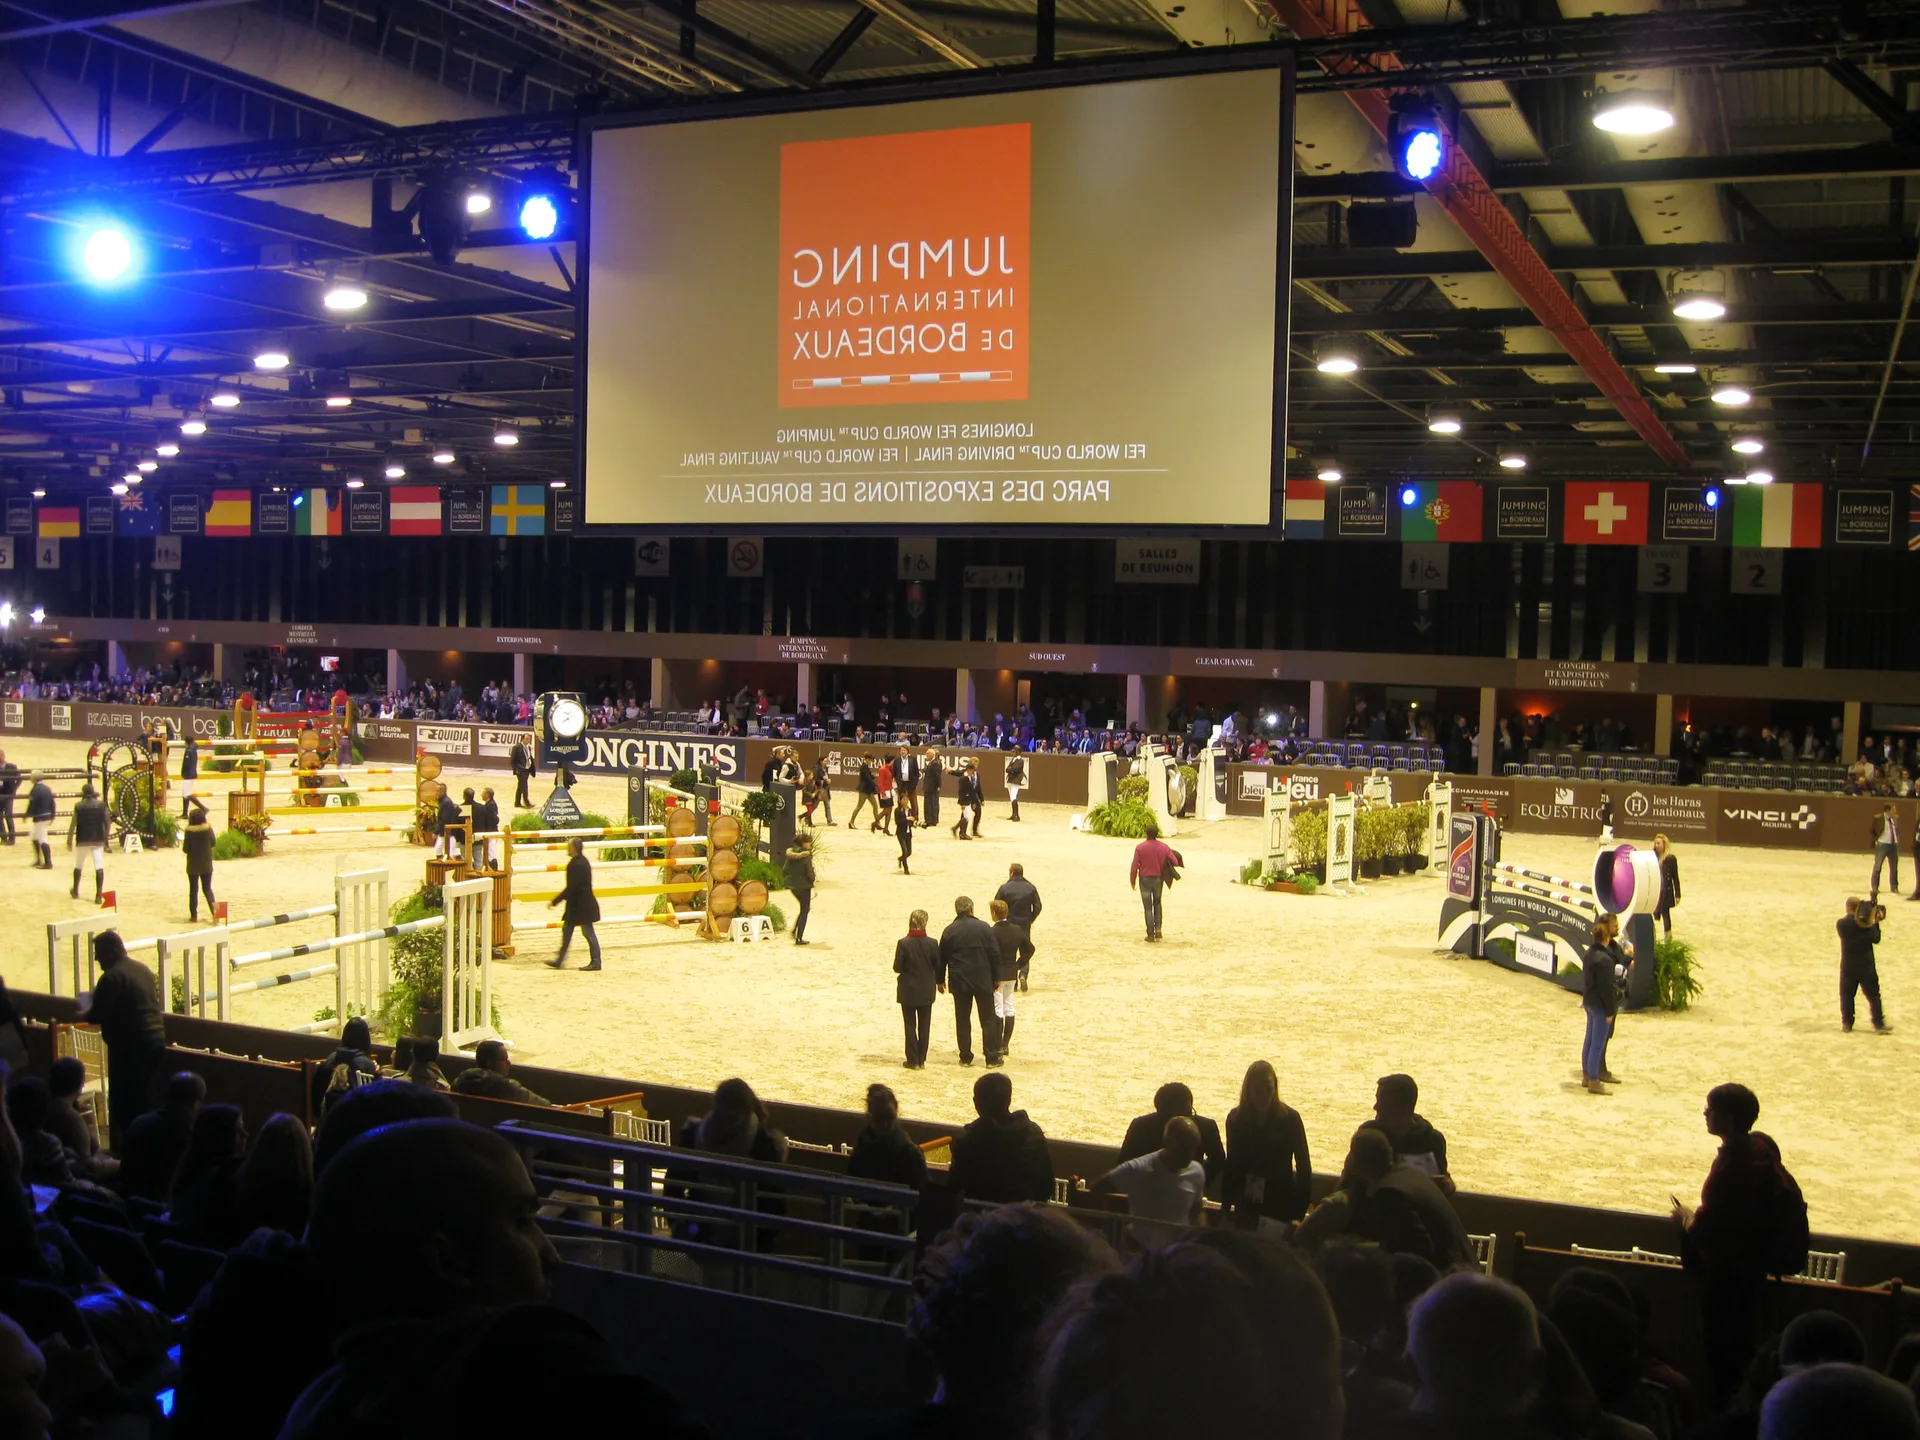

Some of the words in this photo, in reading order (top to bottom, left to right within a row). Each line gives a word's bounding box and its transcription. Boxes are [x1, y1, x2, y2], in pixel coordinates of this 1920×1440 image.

[172, 504, 197, 513] JUMPING
[261, 504, 287, 512] JUMPING
[352, 503, 380, 511] JUMPING
[1342, 500, 1385, 508] JUMP
[1501, 502, 1546, 511] JUMPING
[1668, 503, 1715, 513] JUMPING
[1841, 505, 1890, 515] JUMPING
[1509, 516, 1545, 524] BORDEAUX
[1675, 518, 1714, 526] BORDEAUX
[43, 548, 52, 564] 4
[1139, 548, 1178, 559] SALLES
[1122, 562, 1136, 573] DE
[1653, 563, 1671, 587] 3
[1748, 564, 1766, 588] 2
[778, 644, 828, 652] INTERNATIONAL
[781, 651, 790, 659] DE
[791, 652, 824, 660] BORDEAUX
[1028, 653, 1042, 661] SUD
[1042, 653, 1066, 661] OUEST
[1195, 657, 1219, 666] CLEAR
[1219, 658, 1255, 667] CHANNEL
[1558, 662, 1596, 670] CONGRES
[1544, 669, 1555, 678] ET
[1556, 670, 1610, 679] EXPOSITIONS
[1548, 678, 1560, 686] DE
[1561, 679, 1605, 688] BORDEAUX
[88, 712, 133, 728] KARE
[379, 732, 410, 740] AQUITAINE
[433, 728, 469, 742] EQUIDIA
[445, 744, 469, 754] LIFE
[547, 736, 738, 777] ONGINES
[1292, 774, 1319, 783] france
[1244, 785, 1266, 795] bleu
[332, 796, 339, 804] C
[1669, 796, 1702, 807] Haras
[1652, 807, 1706, 819] nationaux
[1724, 808, 1786, 822] VINCI
[1761, 821, 1792, 829] FACILITIES
[131, 836, 138, 845] 2
[1491, 894, 1517, 906] LONGINES
[1517, 897, 1526, 908] FEI
[1526, 899, 1546, 914] WORLD
[1560, 912, 1587, 932] JUMPING
[741, 921, 750, 933] 6
[761, 919, 770, 931] A
[1519, 942, 1549, 962] Bordeaux
